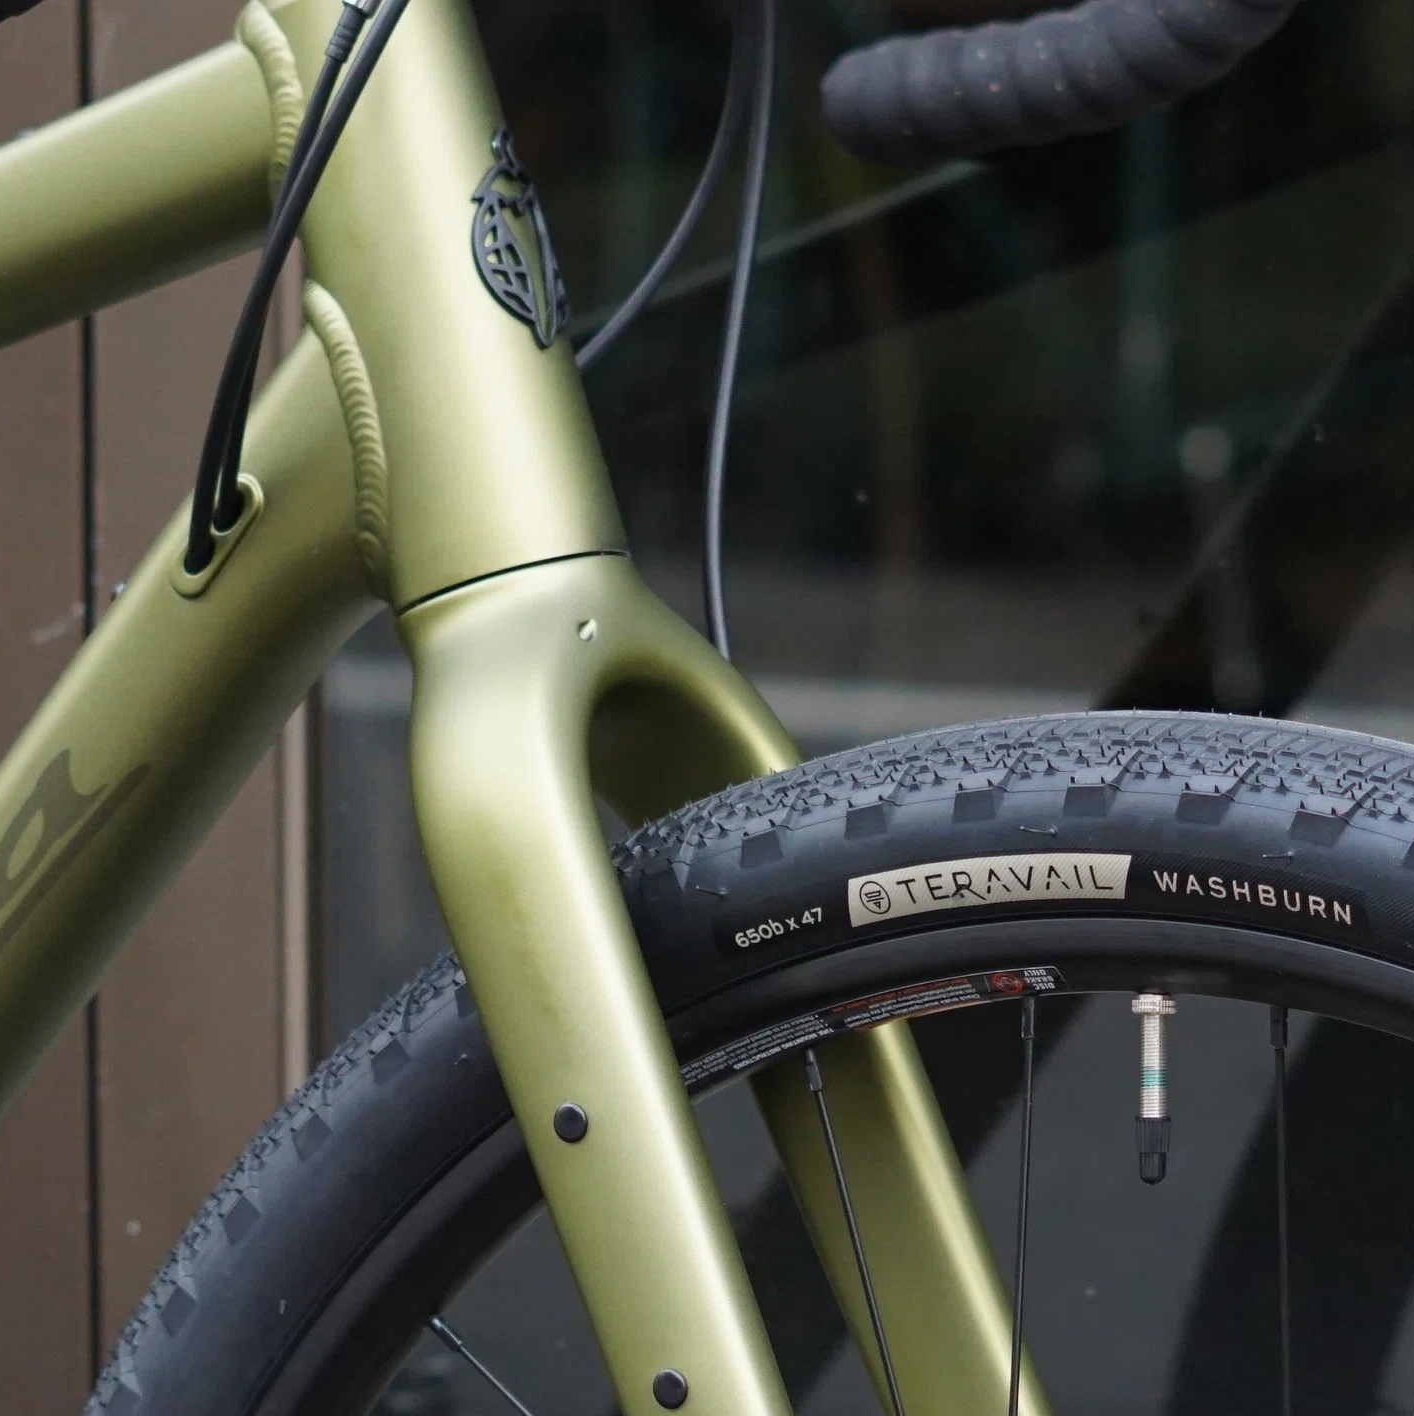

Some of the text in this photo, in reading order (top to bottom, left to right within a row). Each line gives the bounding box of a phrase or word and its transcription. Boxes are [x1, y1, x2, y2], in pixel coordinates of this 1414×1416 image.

[896, 864, 1352, 925] TERAVAIL WASHBURN
[735, 906, 822, 948] 650b x 47
[1024, 969, 1047, 977] ONLY
[1024, 975, 1055, 984] BRAKE
[1034, 982, 1055, 990] DISC
[731, 1027, 834, 1069] TIRE MOUNTING INSTRUCTIONS
